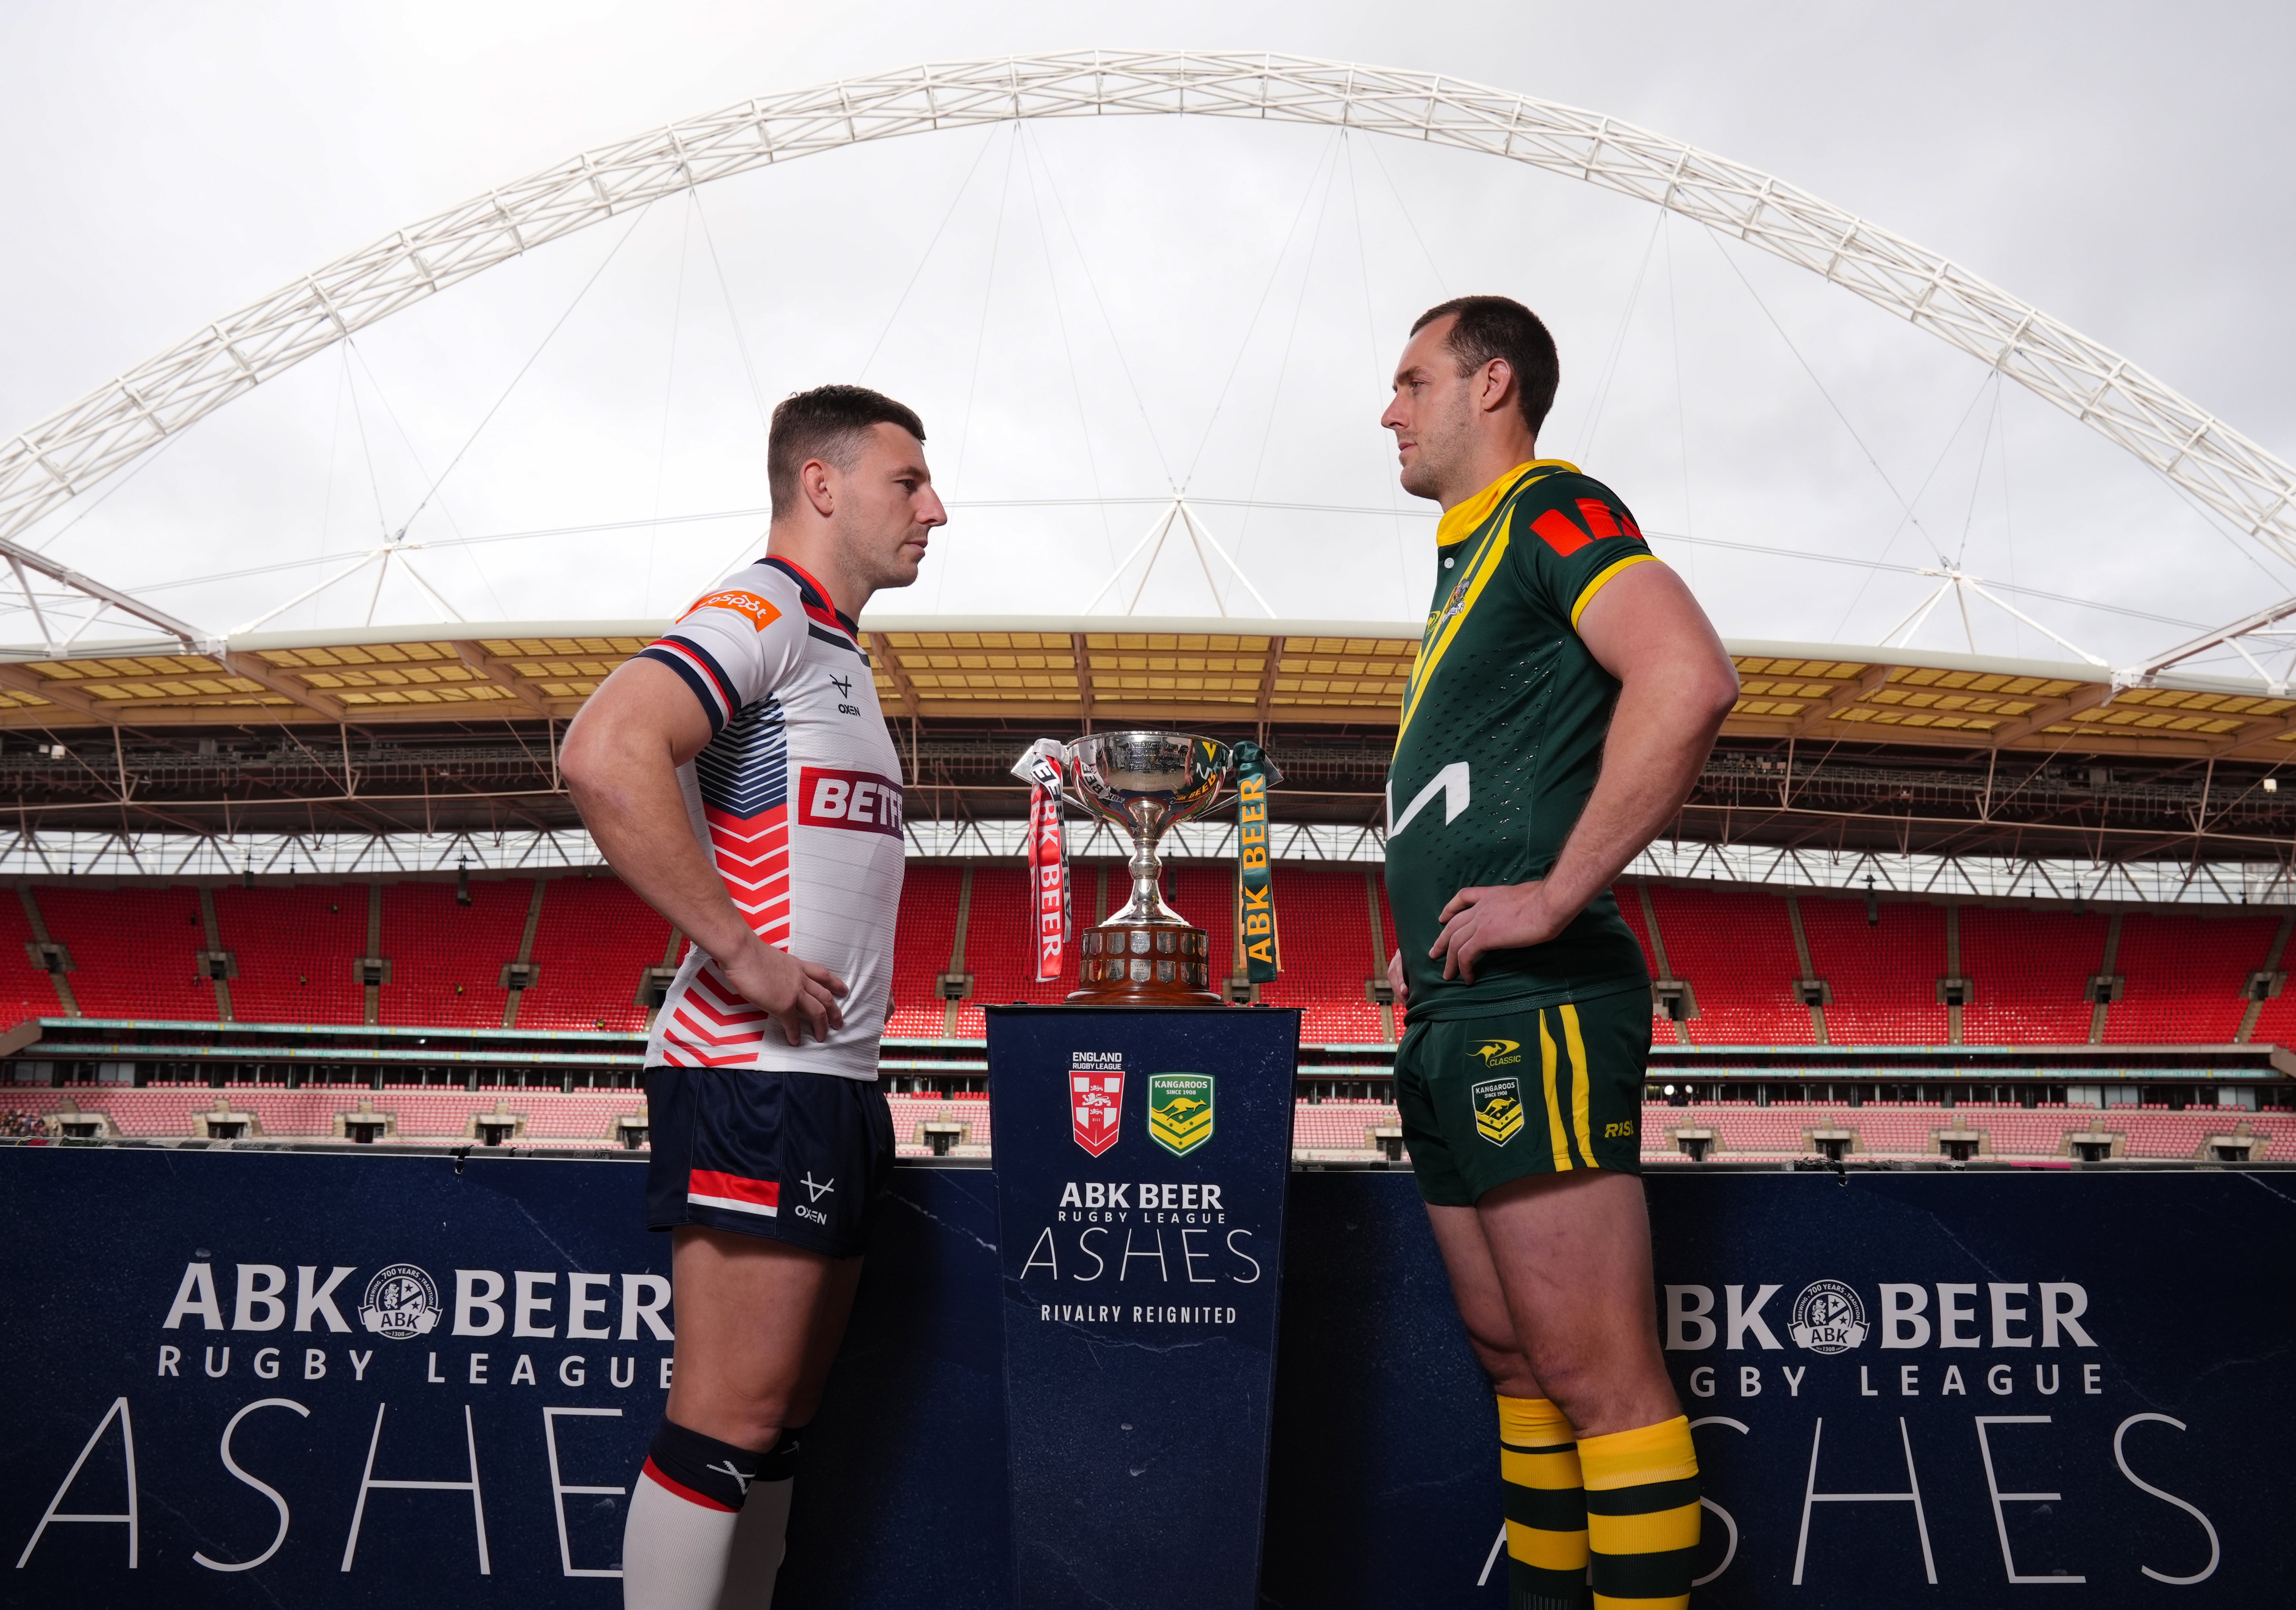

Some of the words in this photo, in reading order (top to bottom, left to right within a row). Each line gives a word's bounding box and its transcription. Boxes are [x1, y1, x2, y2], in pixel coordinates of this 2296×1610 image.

[838, 704, 861, 716] OXEN
[1038, 784, 1059, 850] BK
[1240, 775, 1267, 871] BEER
[1040, 863, 1061, 961] BEER
[1245, 884, 1272, 964] ABK
[1073, 1052, 1122, 1062] ENGLAND
[1490, 1055, 1521, 1067] CLASSIC
[1476, 1082, 1515, 1094] KANGAROOS
[1059, 1182, 1132, 1208] ABK
[1138, 1183, 1224, 1210] BEER
[795, 1205, 827, 1225] OXEN
[1059, 1211, 1127, 1223] RUGBY
[1144, 1212, 1225, 1224] LEAGUE
[1020, 1227, 1261, 1283] ASHES
[162, 1262, 358, 1333] ABK
[451, 1269, 675, 1341] BEER
[369, 1280, 381, 1304] BREWING
[381, 1268, 396, 1280] 700
[398, 1268, 420, 1278] YEARS
[421, 1278, 434, 1305] TRADITION
[1798, 1296, 1808, 1320] BREWING
[1808, 1284, 1822, 1296] 700
[1822, 1284, 1845, 1293] YEARS
[1847, 1292, 1861, 1319] TRADITION
[381, 1312, 420, 1329] ABK
[1041, 1305, 1121, 1323] RIVALRY
[1133, 1306, 1237, 1323] REIGNITED
[1664, 1284, 1784, 1351] BK
[1878, 1282, 2099, 1349] BEER
[1811, 1327, 1849, 1344] ABK
[158, 1345, 373, 1381] RUGBY
[427, 1352, 672, 1389] LEAGUE
[1690, 1366, 1806, 1397] GBY
[1861, 1364, 2102, 1396] LEAGUE
[16, 1397, 625, 1577] ASHE
